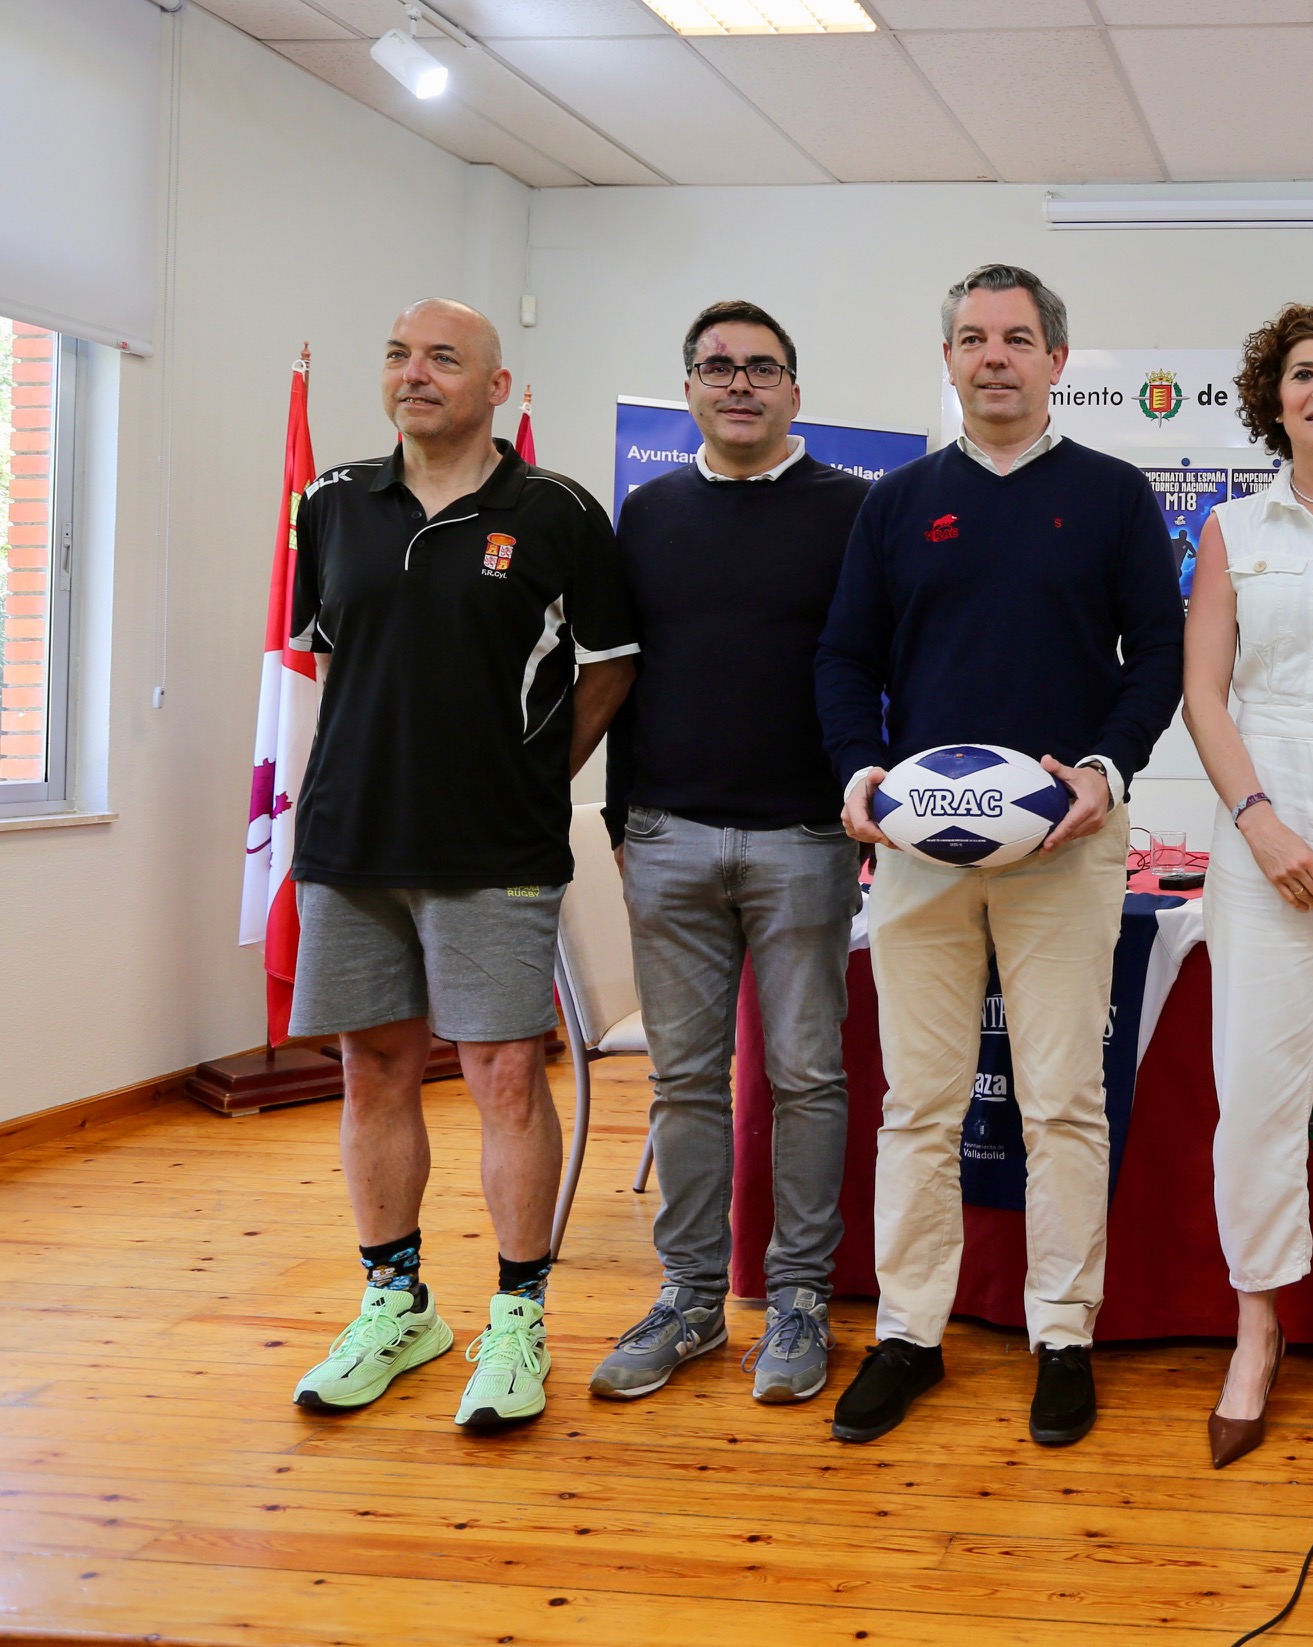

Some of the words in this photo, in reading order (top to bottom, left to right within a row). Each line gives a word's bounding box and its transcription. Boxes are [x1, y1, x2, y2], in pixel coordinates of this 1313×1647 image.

[1197, 384, 1228, 406] de
[1143, 471, 1184, 482] MPEONATO
[1186, 472, 1196, 483] DE
[1198, 471, 1226, 483] ESPAÑA
[1151, 482, 1180, 492] TORNEO
[1181, 482, 1218, 493] NACIONAL
[1241, 482, 1248, 493] Y
[1165, 492, 1197, 511] M18
[909, 788, 1003, 817] VRAC
[970, 1072, 1008, 1098] aza
[963, 1147, 1005, 1160] Valladolid
